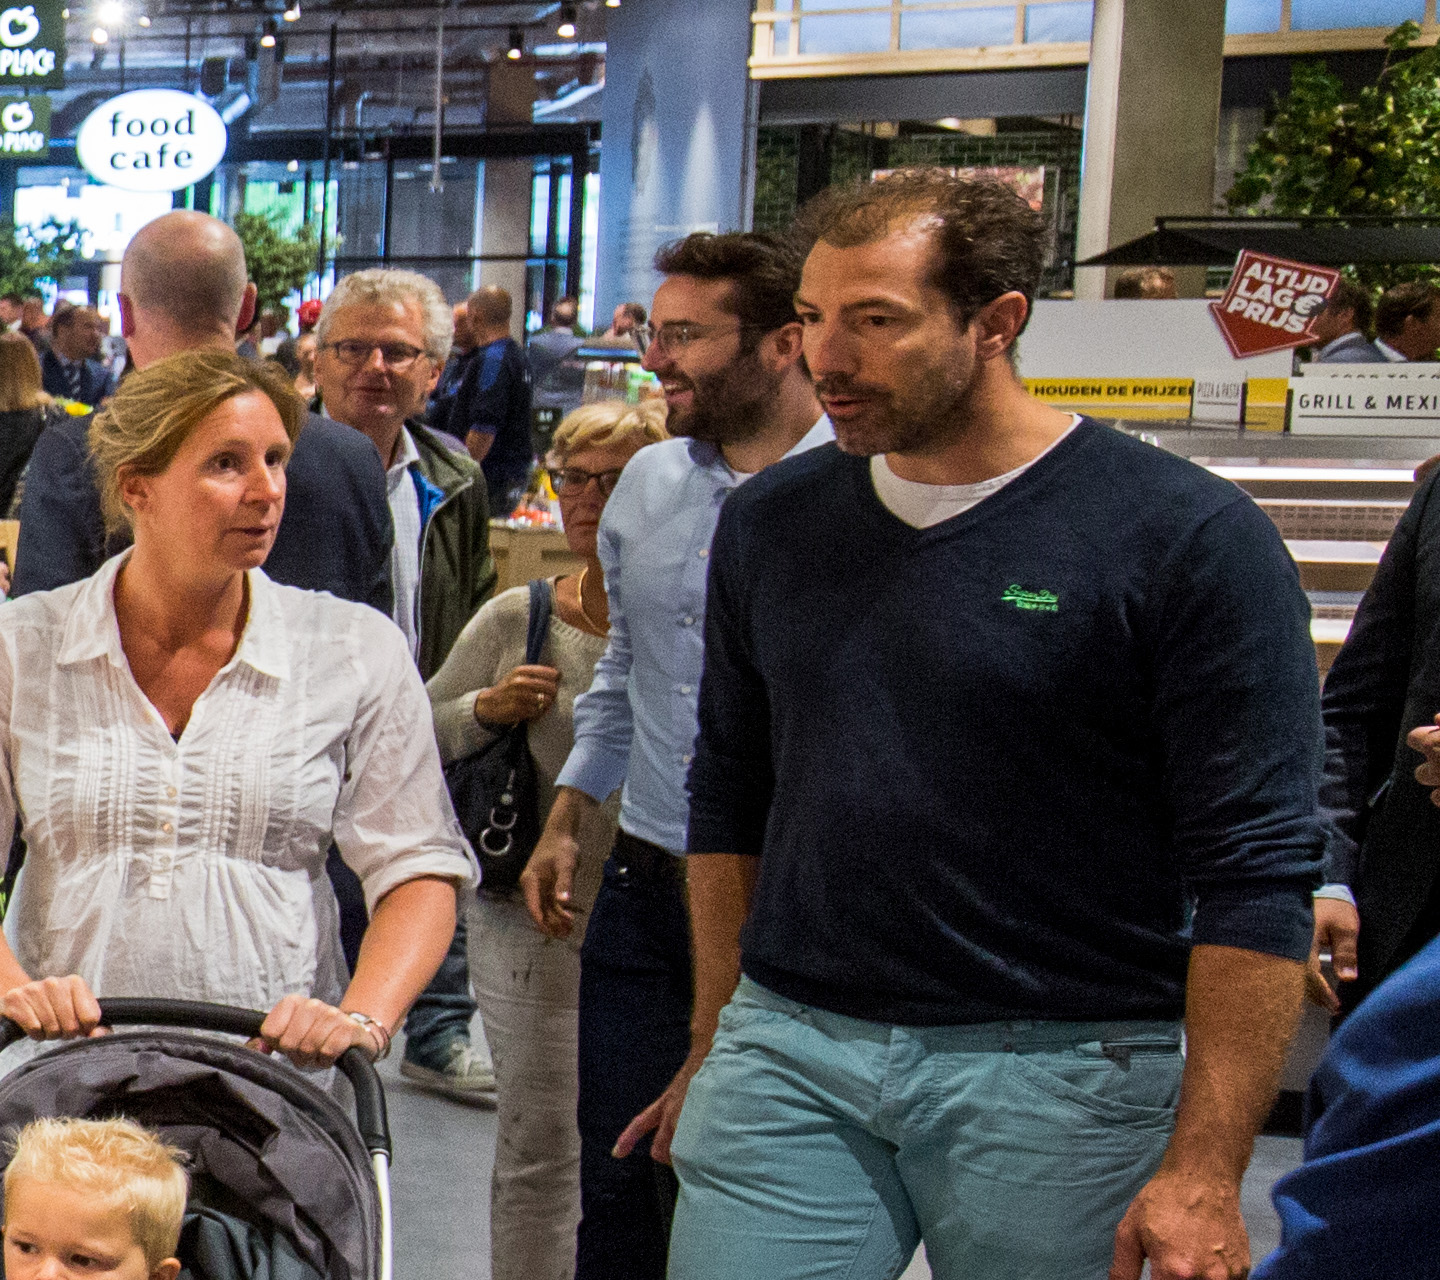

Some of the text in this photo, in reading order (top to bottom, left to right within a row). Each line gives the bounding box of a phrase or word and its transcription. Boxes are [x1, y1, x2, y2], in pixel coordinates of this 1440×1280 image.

[110, 110, 195, 137] food
[1244, 262, 1330, 294] ALTIJD
[1226, 296, 1309, 334] PRIJS
[1035, 385, 1102, 396] HOUDEN
[1107, 385, 1127, 396] DE
[1299, 394, 1355, 410] GRILL
[1365, 396, 1376, 410] &
